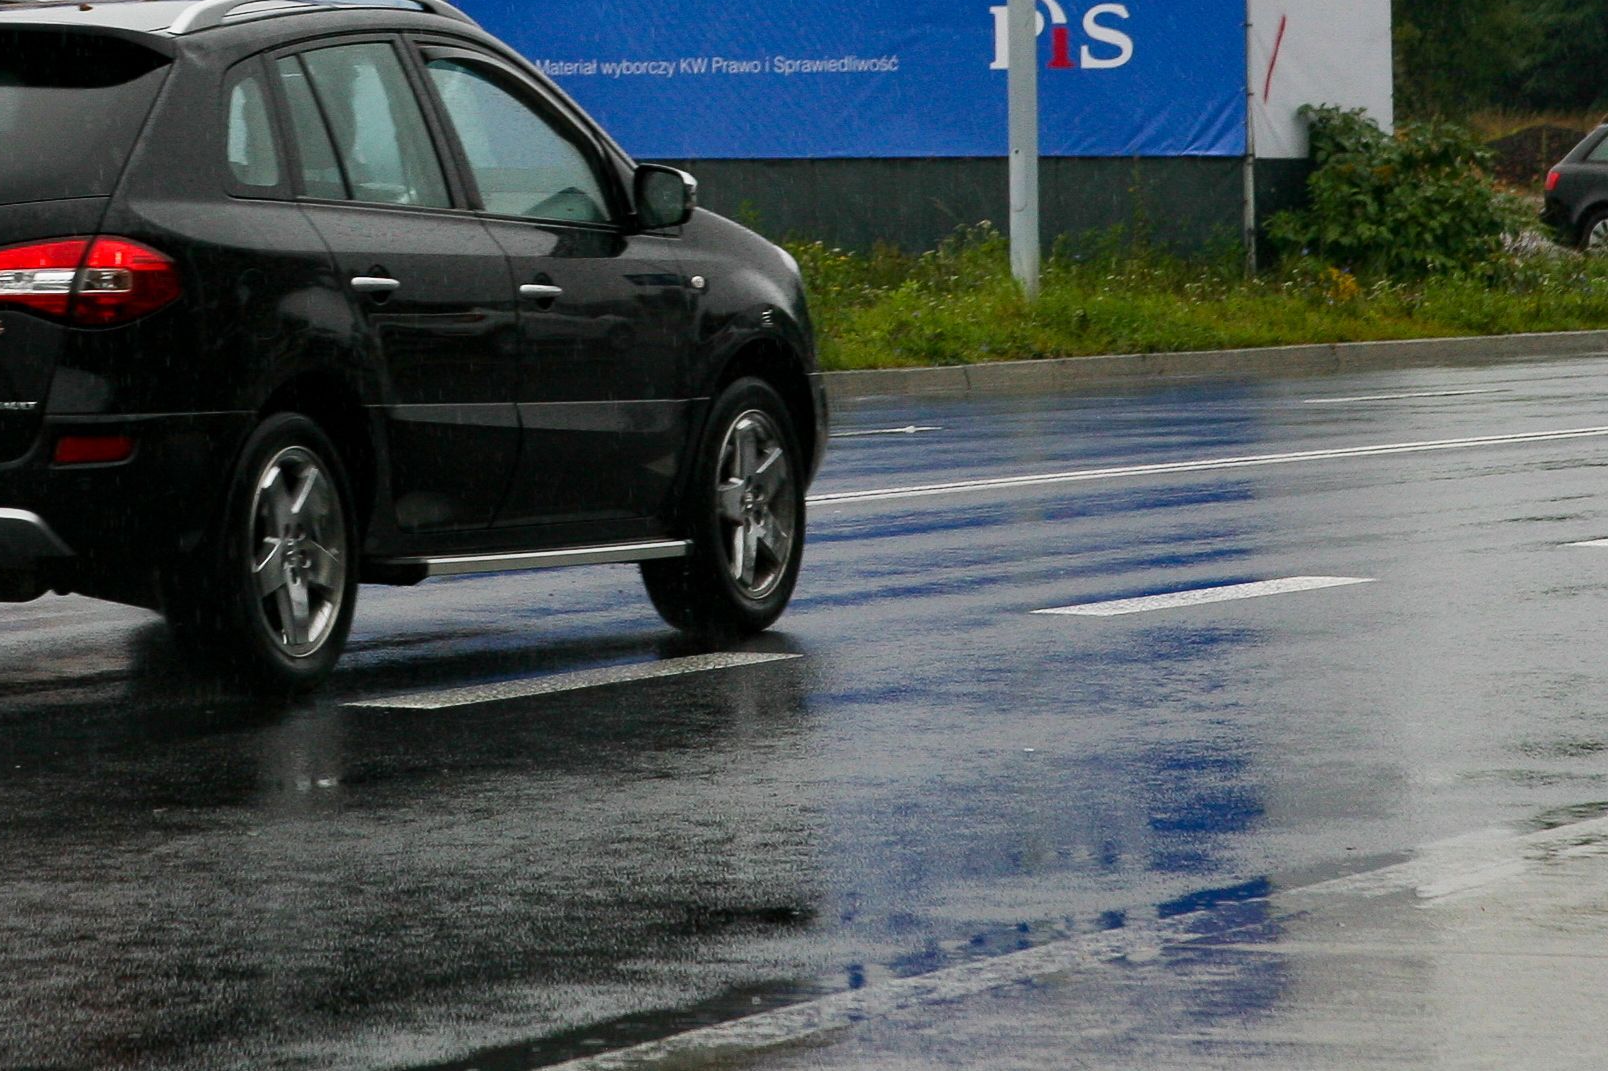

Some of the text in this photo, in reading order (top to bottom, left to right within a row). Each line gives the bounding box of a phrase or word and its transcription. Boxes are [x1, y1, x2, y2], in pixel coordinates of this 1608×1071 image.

[535, 55, 900, 79] Materiał wyborczy KW Prawo i Sprawiedliwość
